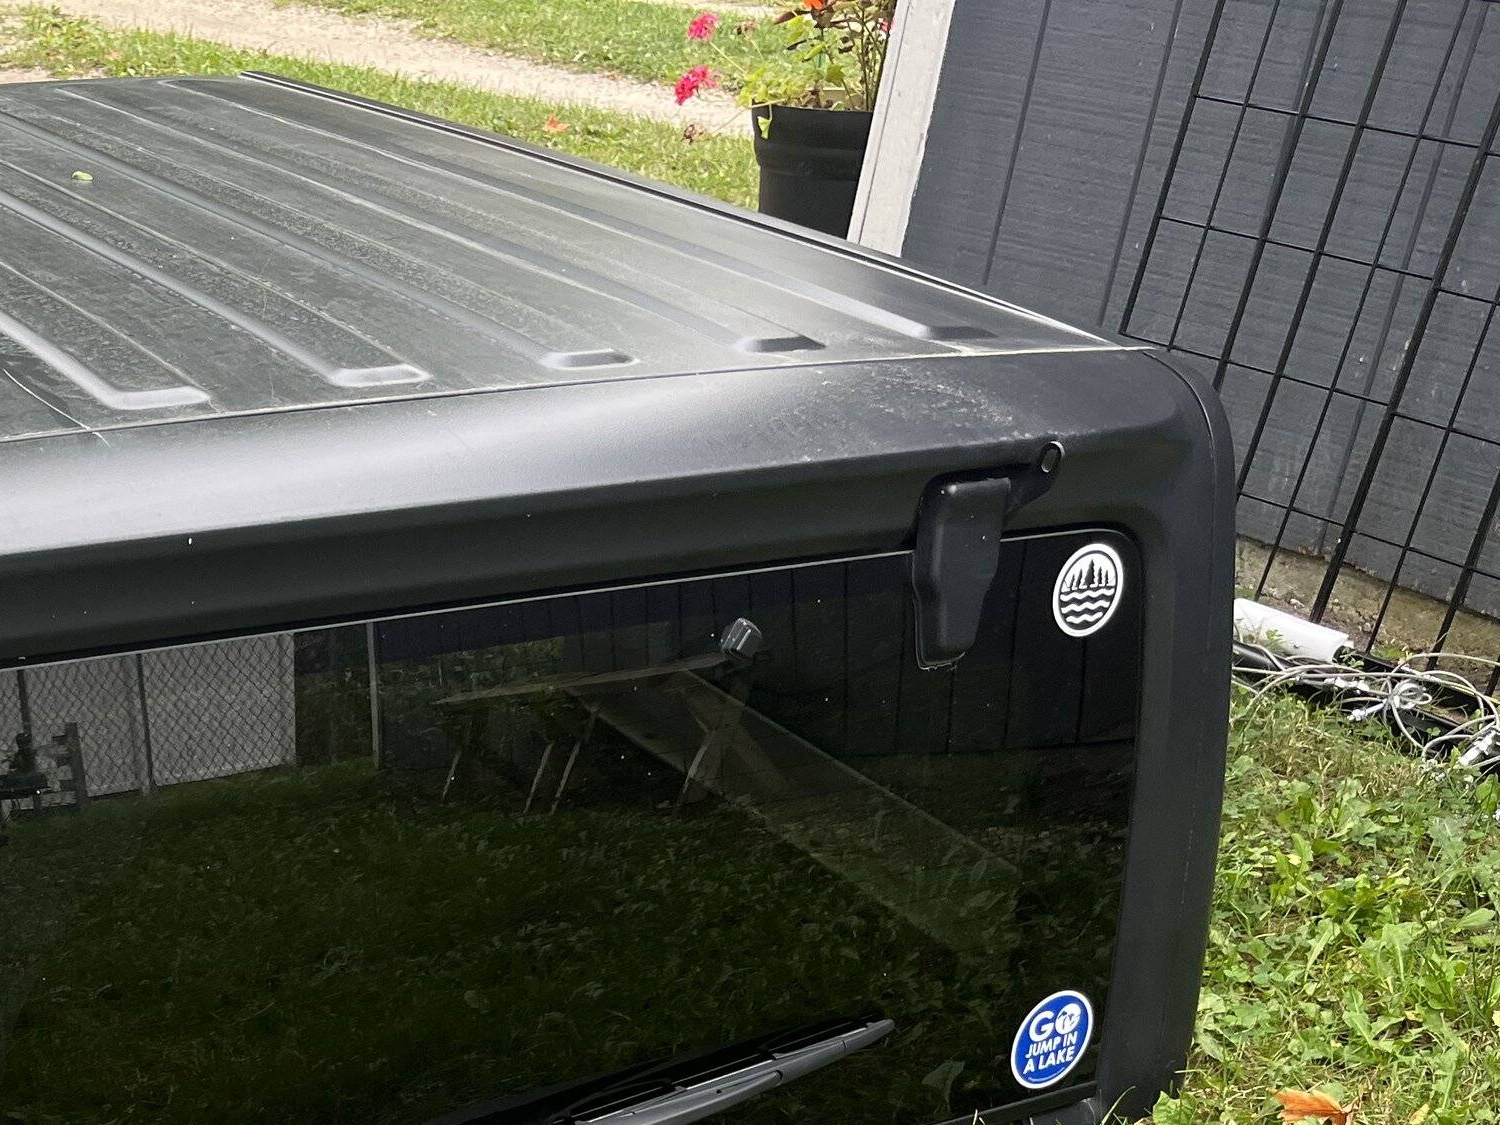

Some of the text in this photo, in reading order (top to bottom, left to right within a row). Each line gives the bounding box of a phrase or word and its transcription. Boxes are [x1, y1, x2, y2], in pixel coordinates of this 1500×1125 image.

[1029, 1003, 1081, 1042] GO
[1025, 1031, 1078, 1058] JUMP IN
[1023, 1046, 1075, 1074] A LAKE
